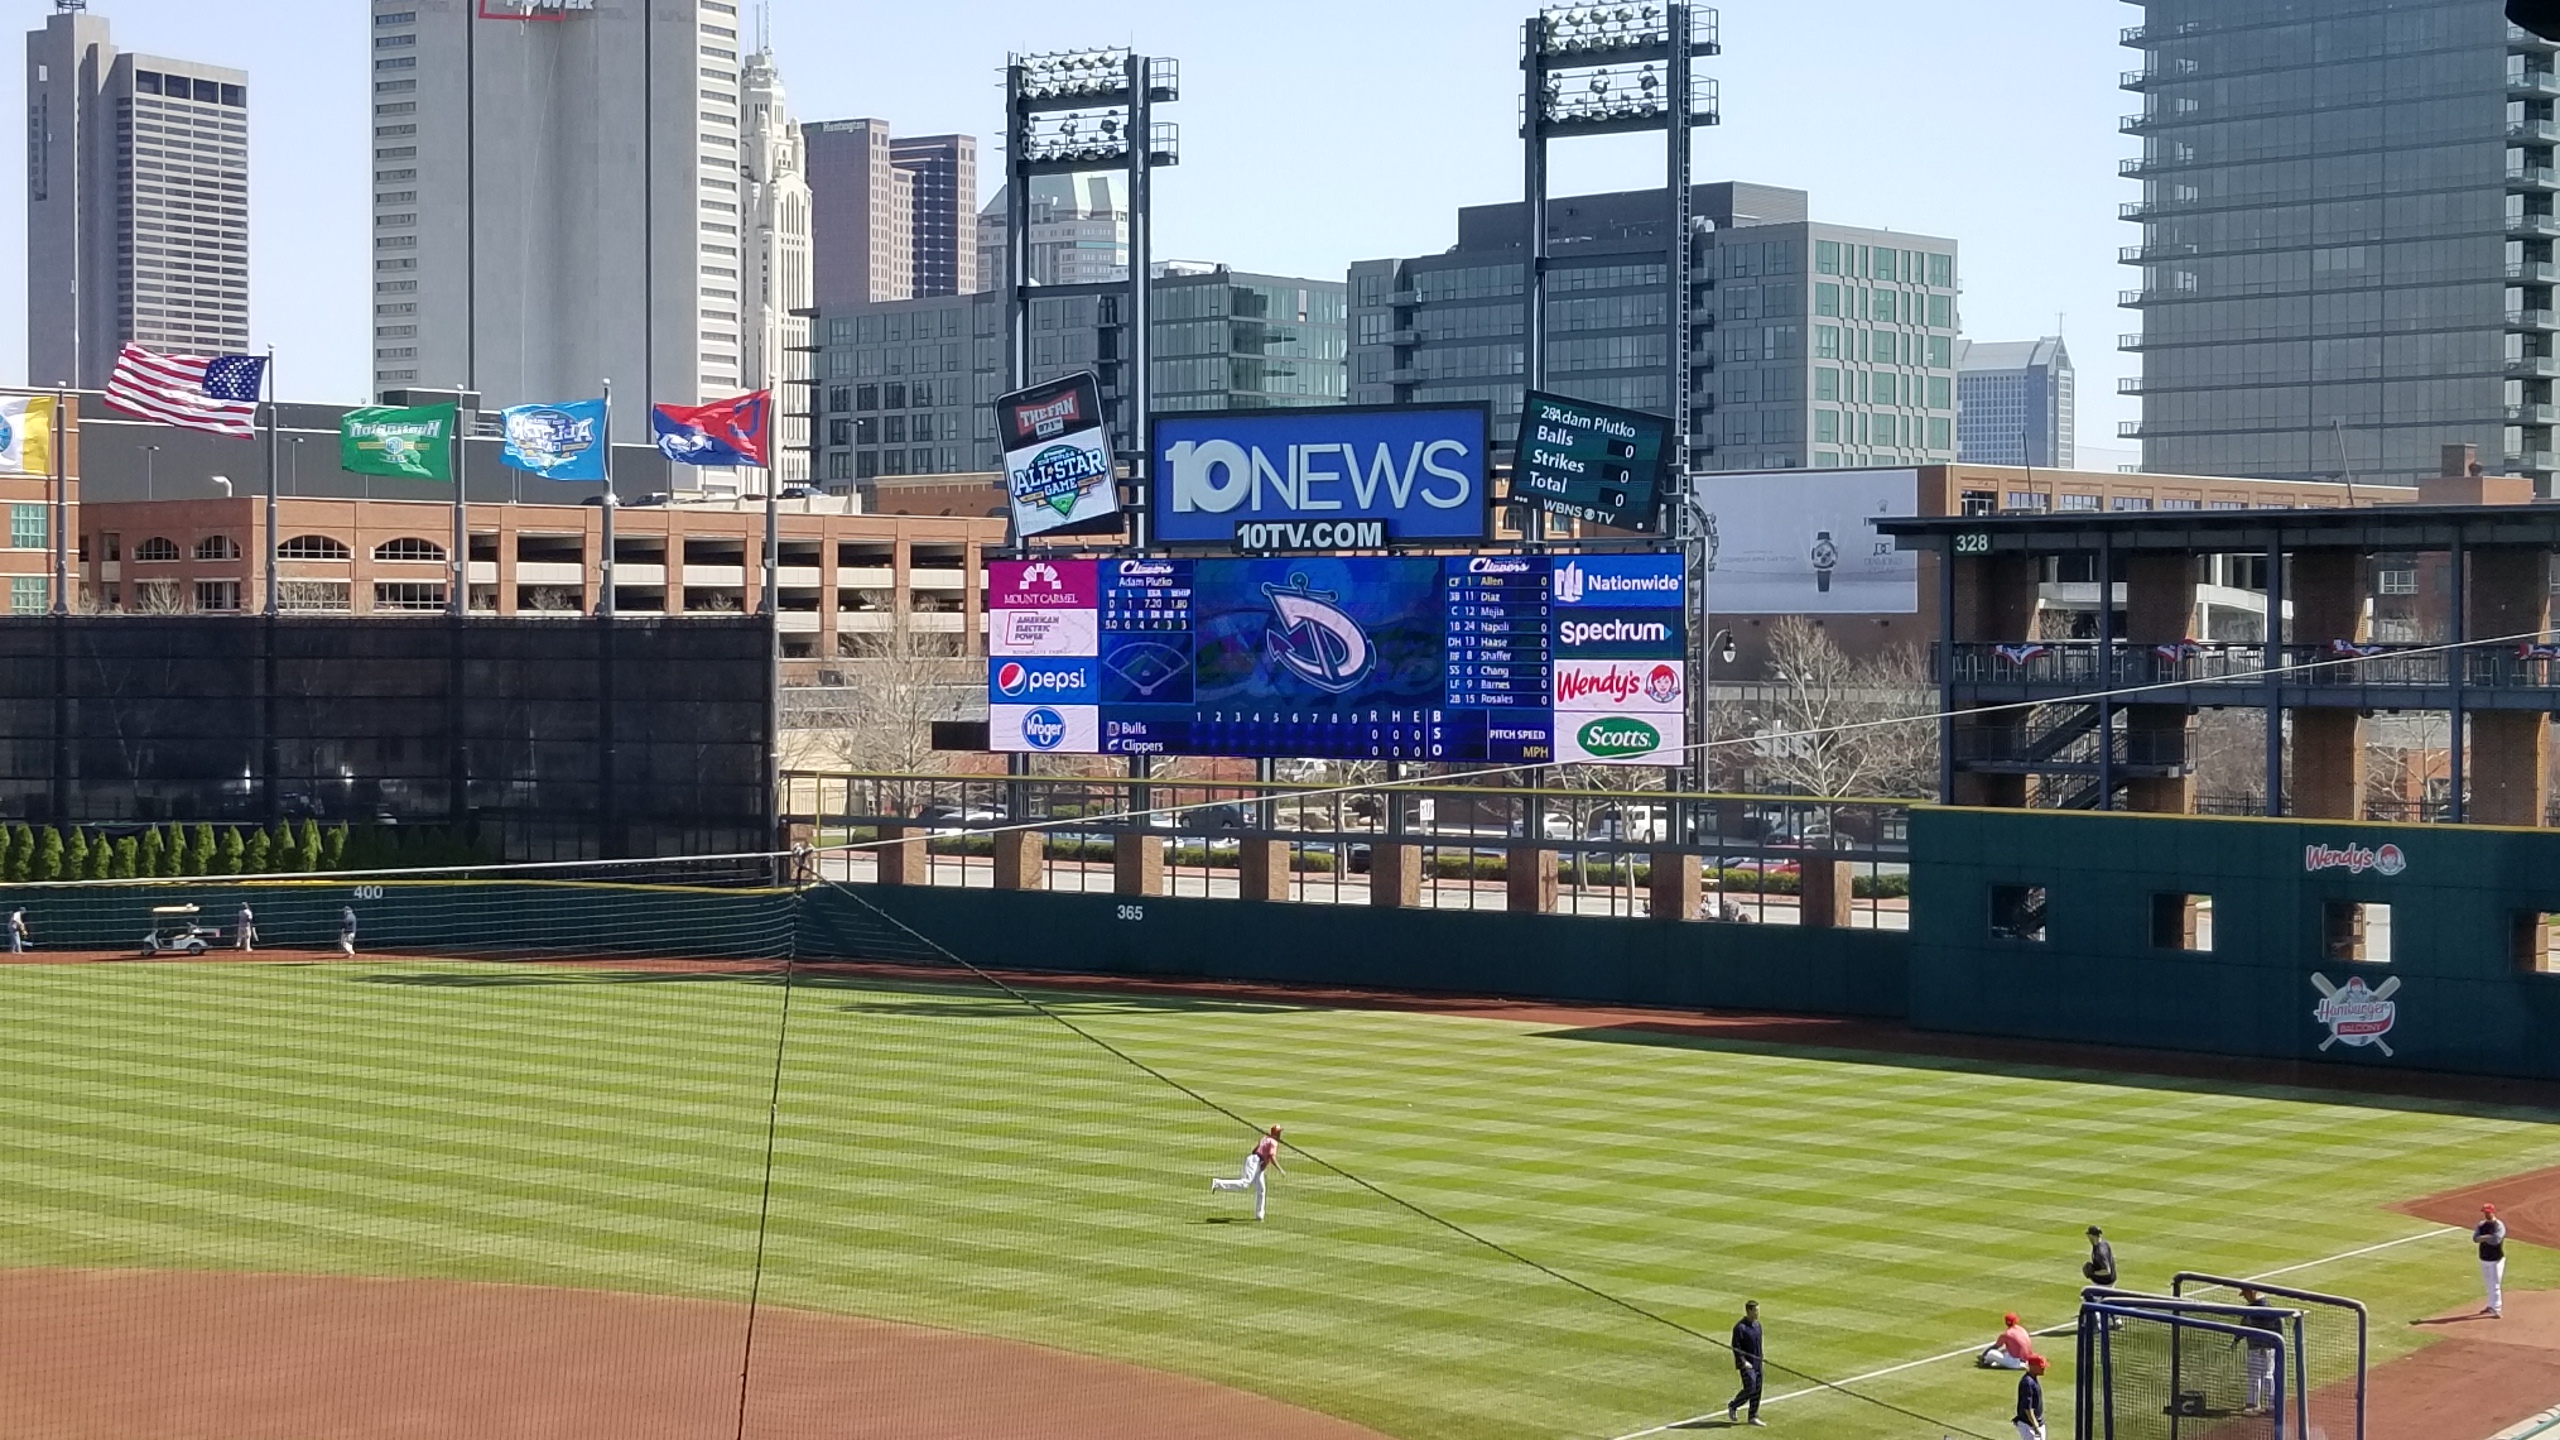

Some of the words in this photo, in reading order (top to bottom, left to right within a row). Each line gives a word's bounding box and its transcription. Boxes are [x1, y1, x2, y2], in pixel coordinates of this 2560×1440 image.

[1594, 417, 1636, 438] Plutko
[1537, 425, 1574, 447] Balls
[1625, 445, 1634, 458] 0
[1532, 449, 1585, 473] Strikes
[1620, 470, 1629, 483] 0
[1044, 477, 1078, 496] GAME
[1529, 471, 1567, 493] Total
[1615, 494, 1624, 507] 0
[1543, 498, 1582, 518] WBNS
[1597, 511, 1615, 525] TV
[1236, 521, 1382, 549] 10TV.COM
[1956, 534, 1988, 551] 328
[1118, 577, 1144, 587] Adam
[1541, 576, 1547, 586] 0
[1588, 575, 1679, 591] Nationwide
[1541, 591, 1547, 601] 0
[1541, 606, 1547, 616] 0
[1541, 623, 1547, 633] 0
[1560, 619, 1664, 646] Spectrum
[1541, 638, 1547, 648] 0
[1541, 652, 1547, 661] 0
[1541, 666, 1547, 676] 0
[1029, 667, 1087, 693] pepsi
[1541, 680, 1547, 689] 0
[1557, 664, 1640, 702] Wendy's
[1541, 696, 1547, 705] 0
[1196, 712, 1201, 722] 1
[1216, 712, 1222, 722] 2
[1236, 712, 1241, 722] 3
[1253, 712, 1260, 722] 4
[1273, 712, 1279, 723] 5
[1292, 713, 1298, 723] 6
[1312, 713, 1318, 724] 7
[1331, 713, 1338, 724] 8
[1352, 713, 1358, 724] 9
[1370, 711, 1377, 722] R
[1392, 711, 1400, 722] H
[1414, 711, 1420, 722] E
[1434, 711, 1441, 722] B
[1027, 713, 1063, 745] Kroger
[1122, 722, 1147, 735] Bulls
[1372, 730, 1378, 739] 0
[1393, 730, 1399, 740] 0
[1414, 730, 1420, 740] 0
[1434, 728, 1441, 739] S
[1490, 730, 1515, 739] PITCH
[1517, 730, 1546, 739] SPEED
[1122, 739, 1163, 753] Clippers
[1372, 746, 1378, 756] 0
[1393, 746, 1399, 756] 0
[1414, 747, 1420, 756] 0
[1523, 747, 1548, 758] MPH
[2307, 842, 2374, 873] Wendy's
[354, 885, 383, 899] 400
[1117, 904, 1143, 920] 365
[2319, 1000, 2385, 1020] Hamburger
